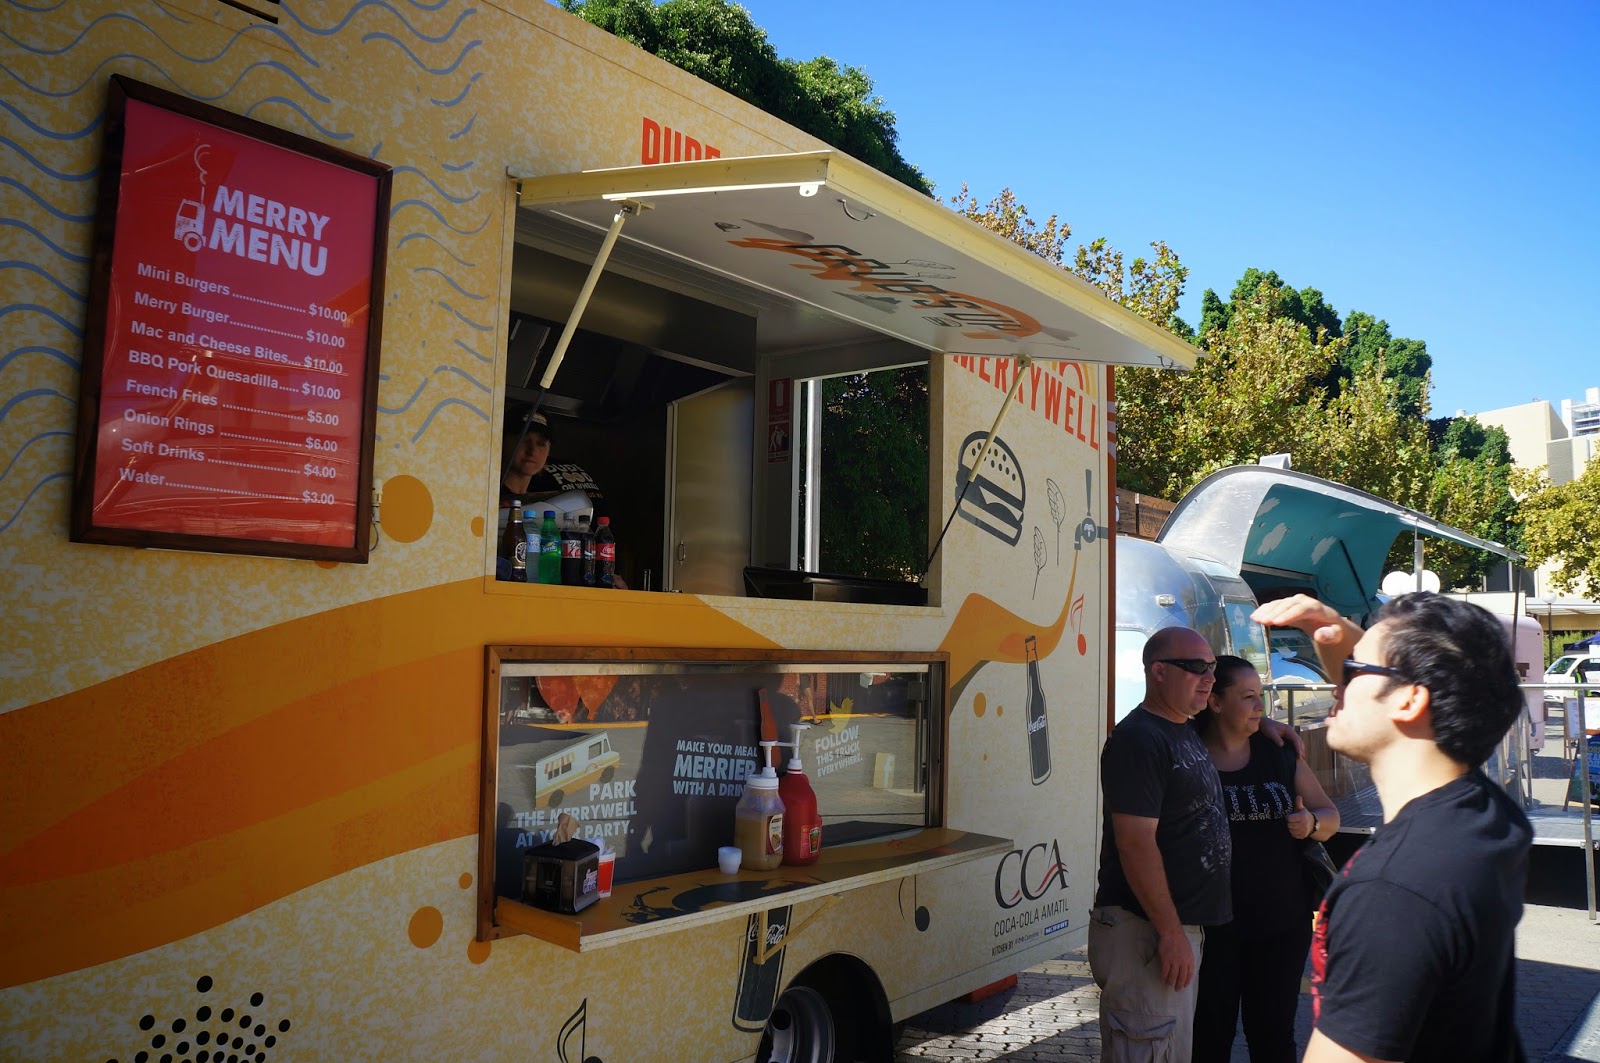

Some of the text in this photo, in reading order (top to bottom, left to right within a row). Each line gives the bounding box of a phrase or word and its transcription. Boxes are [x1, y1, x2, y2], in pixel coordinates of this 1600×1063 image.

[213, 185, 330, 241] MERRY
[209, 218, 328, 276] MENU
[137, 262, 348, 322] Mini Burgers $10.00
[134, 291, 345, 348] Merry Burger $10.00
[131, 320, 343, 374] Mac and Cheese Bites $10.00
[128, 350, 341, 400] BBQ Pork Quesadilla $10.00
[126, 379, 339, 426] French Fries $5.00
[124, 408, 338, 452] Onion Rings $6.00
[121, 437, 336, 479] Soft Drinks $4.00
[119, 467, 335, 506] Water $3.00
[552, 472, 593, 485] FOOD
[676, 740, 757, 757] MAKE YOUR MEAL
[816, 725, 859, 753] FOLLOW
[816, 741, 860, 766] THIS TRUCK
[673, 754, 756, 781] MERRIER
[817, 753, 863, 778] EVERYWHERE.
[589, 780, 637, 801] PARK
[673, 780, 745, 797] WITH A DRIN
[515, 820, 635, 848] AT YOR PARTY.
[516, 810, 545, 828] THE
[994, 838, 1070, 909] CCA
[994, 898, 1069, 937] COCA-COLA AMATIL
